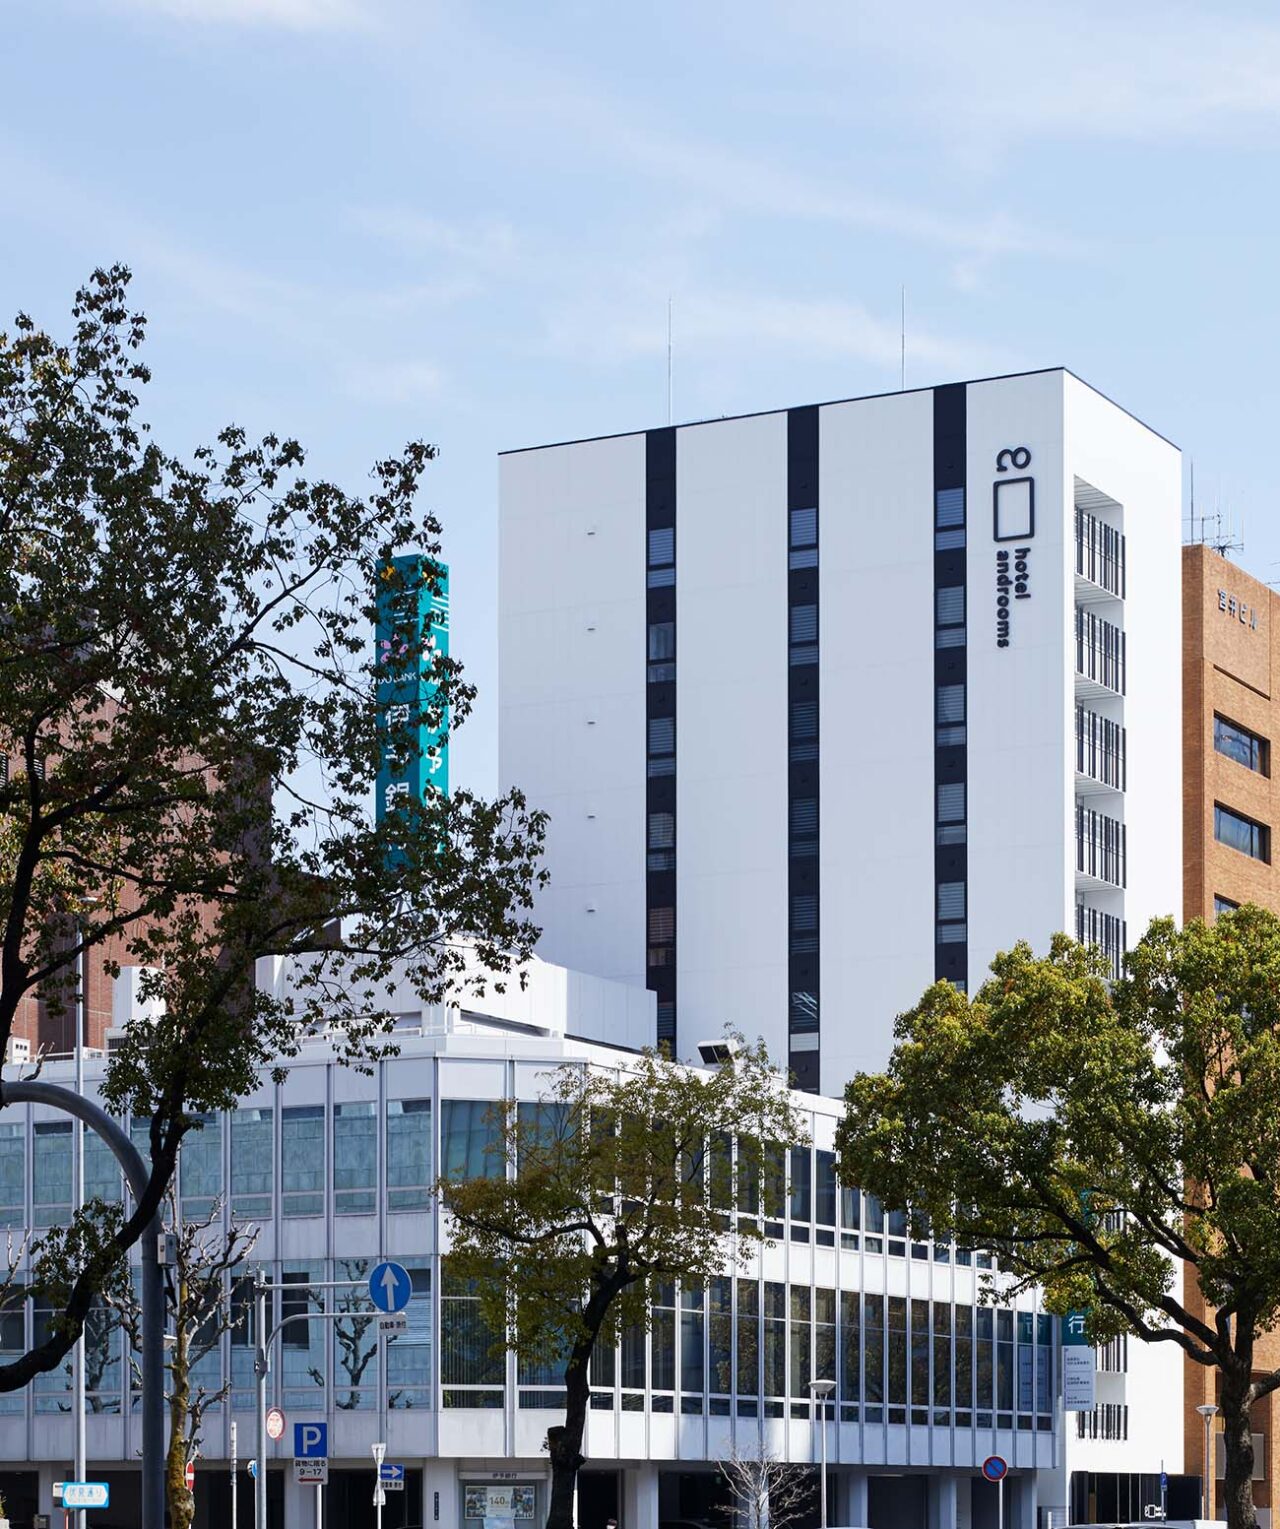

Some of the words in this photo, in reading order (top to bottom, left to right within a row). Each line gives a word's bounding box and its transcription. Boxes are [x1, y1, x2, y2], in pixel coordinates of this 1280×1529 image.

[1014, 547, 1032, 600] hotel
[996, 550, 1013, 648] androoms
[1068, 1315, 1087, 1335] 行
[302, 1426, 322, 1455] P
